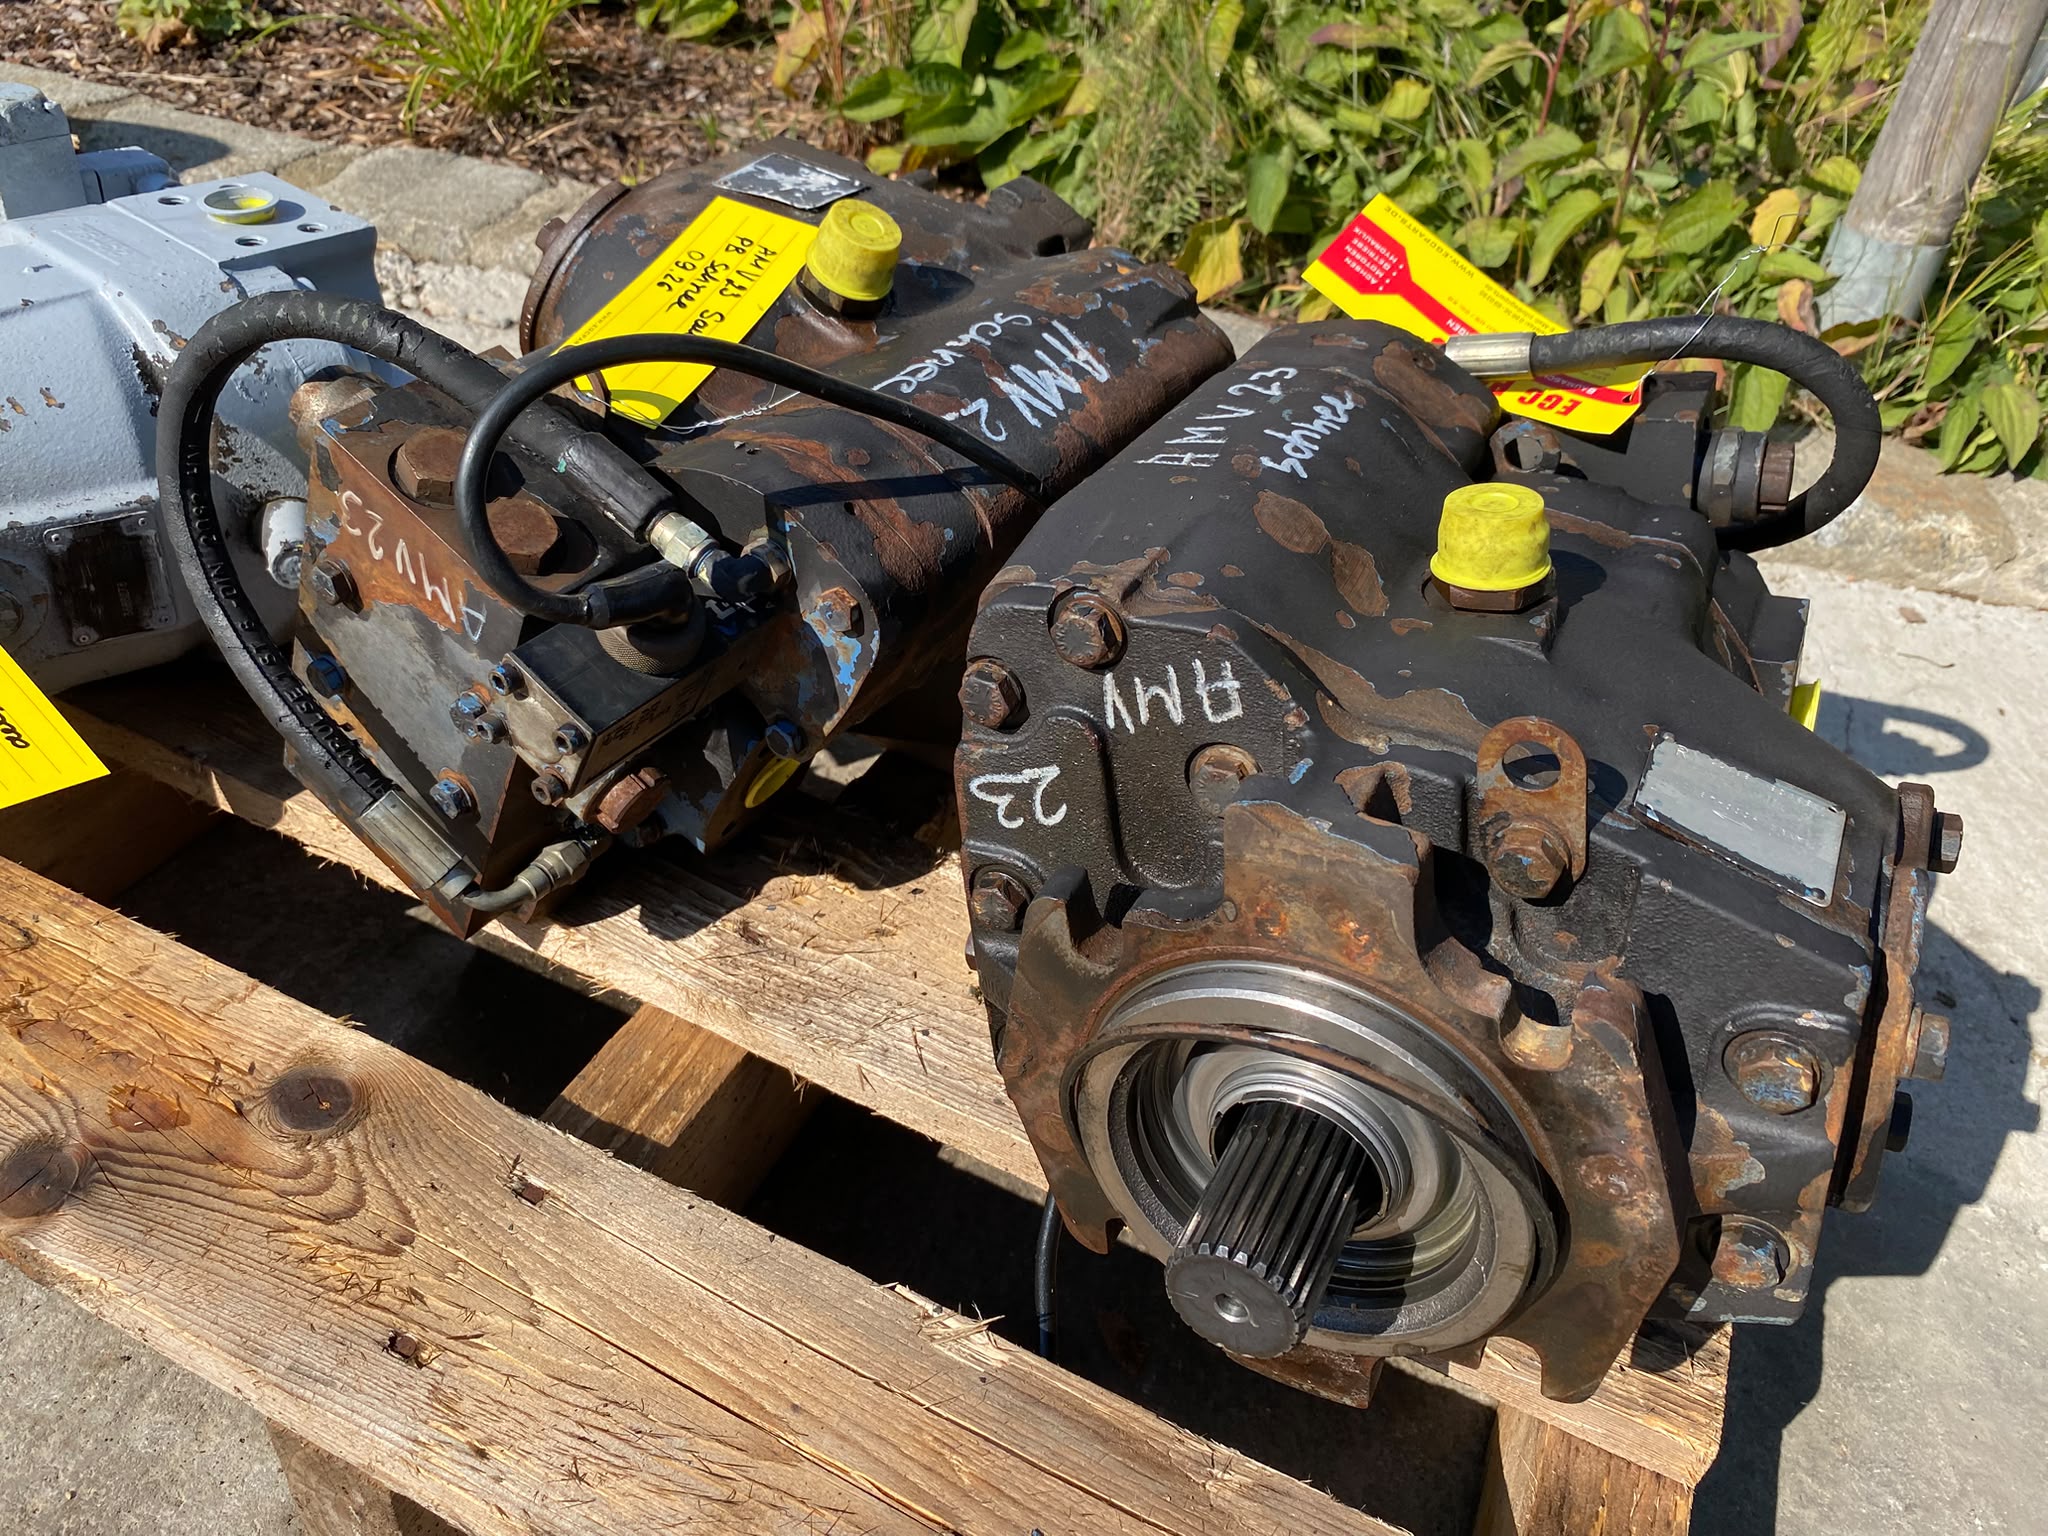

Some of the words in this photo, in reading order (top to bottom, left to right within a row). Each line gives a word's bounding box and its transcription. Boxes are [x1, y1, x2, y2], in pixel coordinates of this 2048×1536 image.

[1344, 244, 1384, 278] MOTOREN
[991, 320, 1110, 429] AMV
[1228, 368, 1299, 397] 23
[1517, 388, 1583, 416] EGC
[342, 490, 384, 561] 23
[395, 538, 488, 644] AMV
[1103, 658, 1244, 735] AMV
[968, 764, 1068, 830] 23
